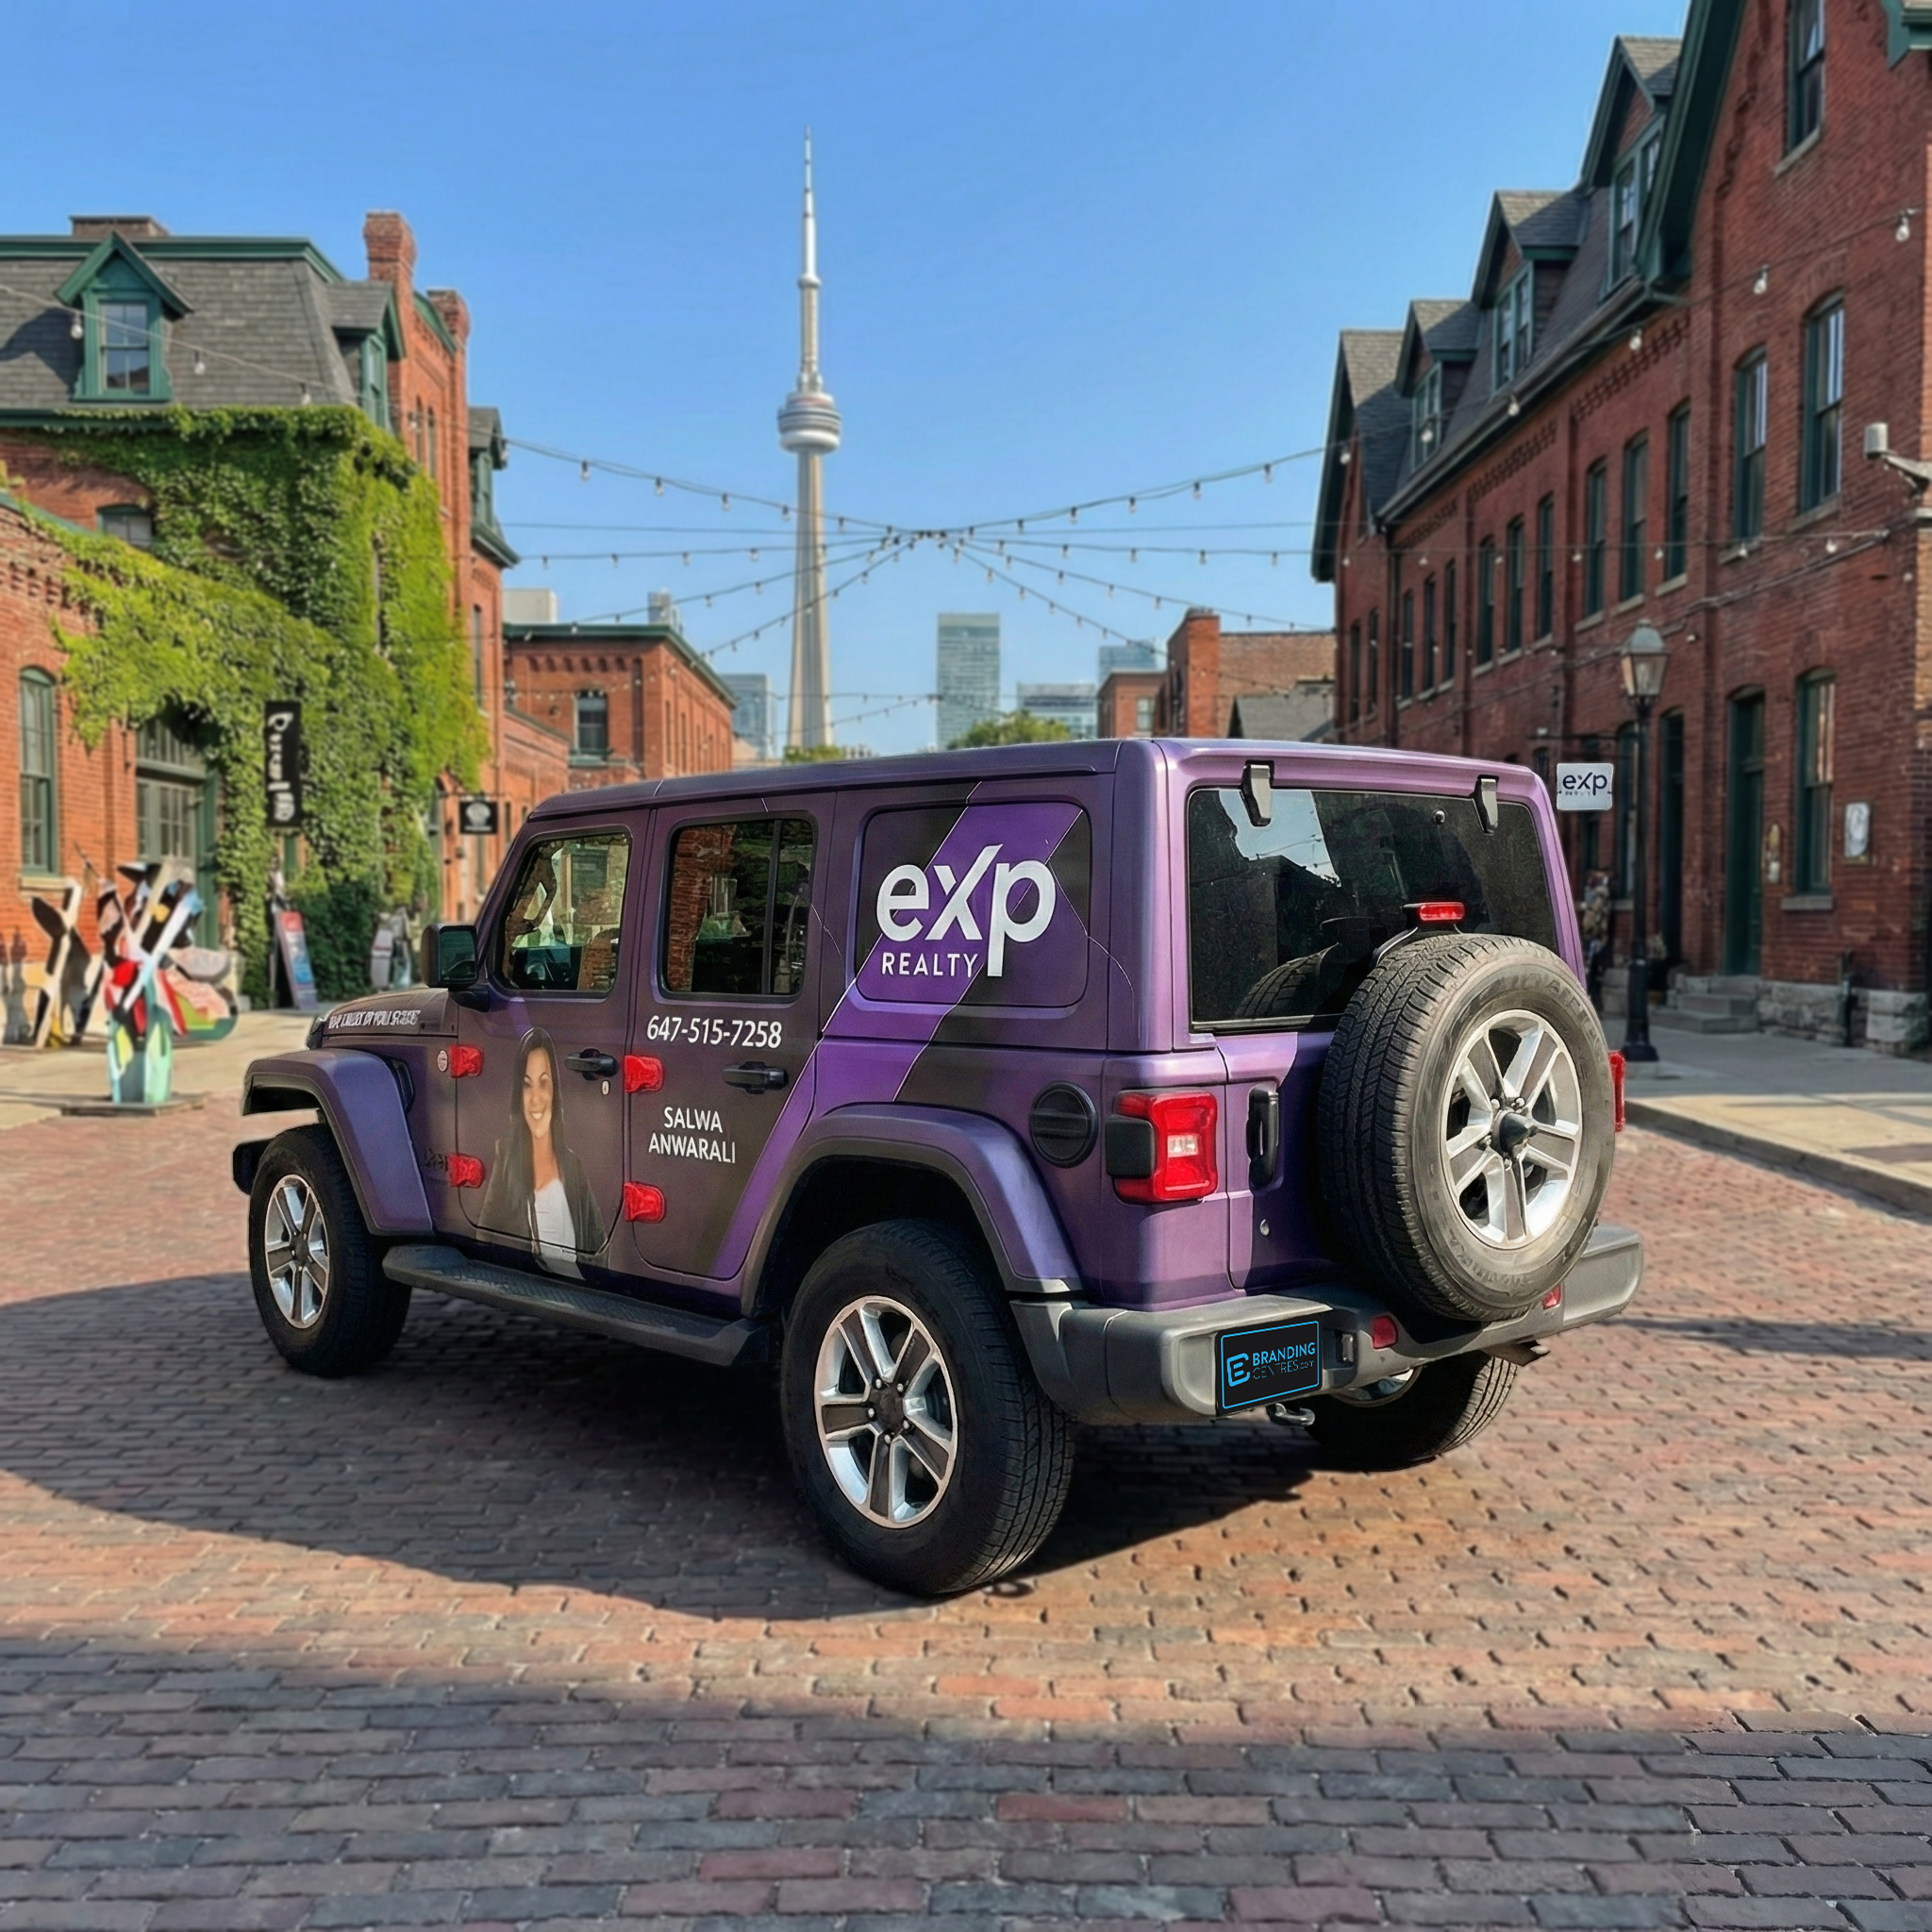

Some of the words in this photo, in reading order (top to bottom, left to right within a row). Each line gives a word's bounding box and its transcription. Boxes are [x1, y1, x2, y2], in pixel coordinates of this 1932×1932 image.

[881, 952, 978, 978] REALTY
[646, 1015, 782, 1049] 647-515-7258
[663, 1107, 724, 1134] SALWA
[648, 1132, 736, 1164] ANWARALI
[1252, 1341, 1316, 1367] BRANDING
